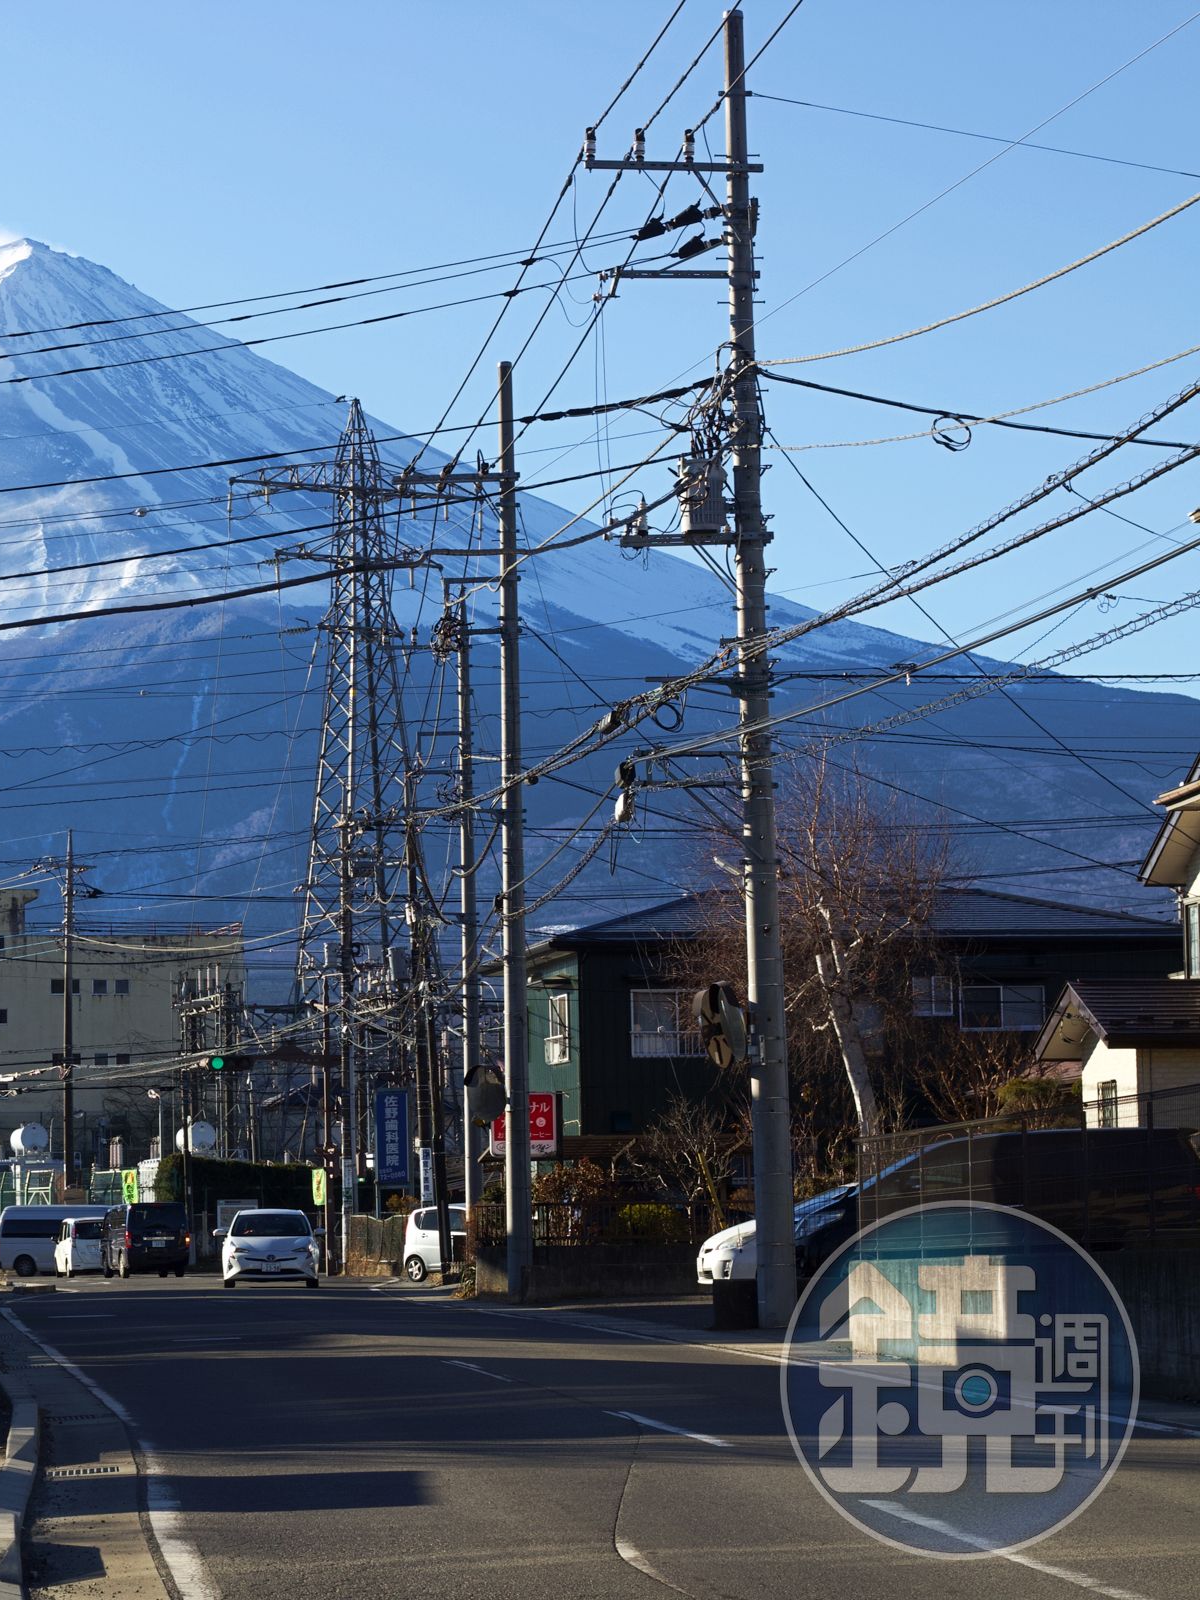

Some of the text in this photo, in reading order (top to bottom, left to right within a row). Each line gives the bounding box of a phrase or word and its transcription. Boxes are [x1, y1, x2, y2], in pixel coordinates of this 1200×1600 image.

[384, 1095, 400, 1167] 佐野歯科医院
